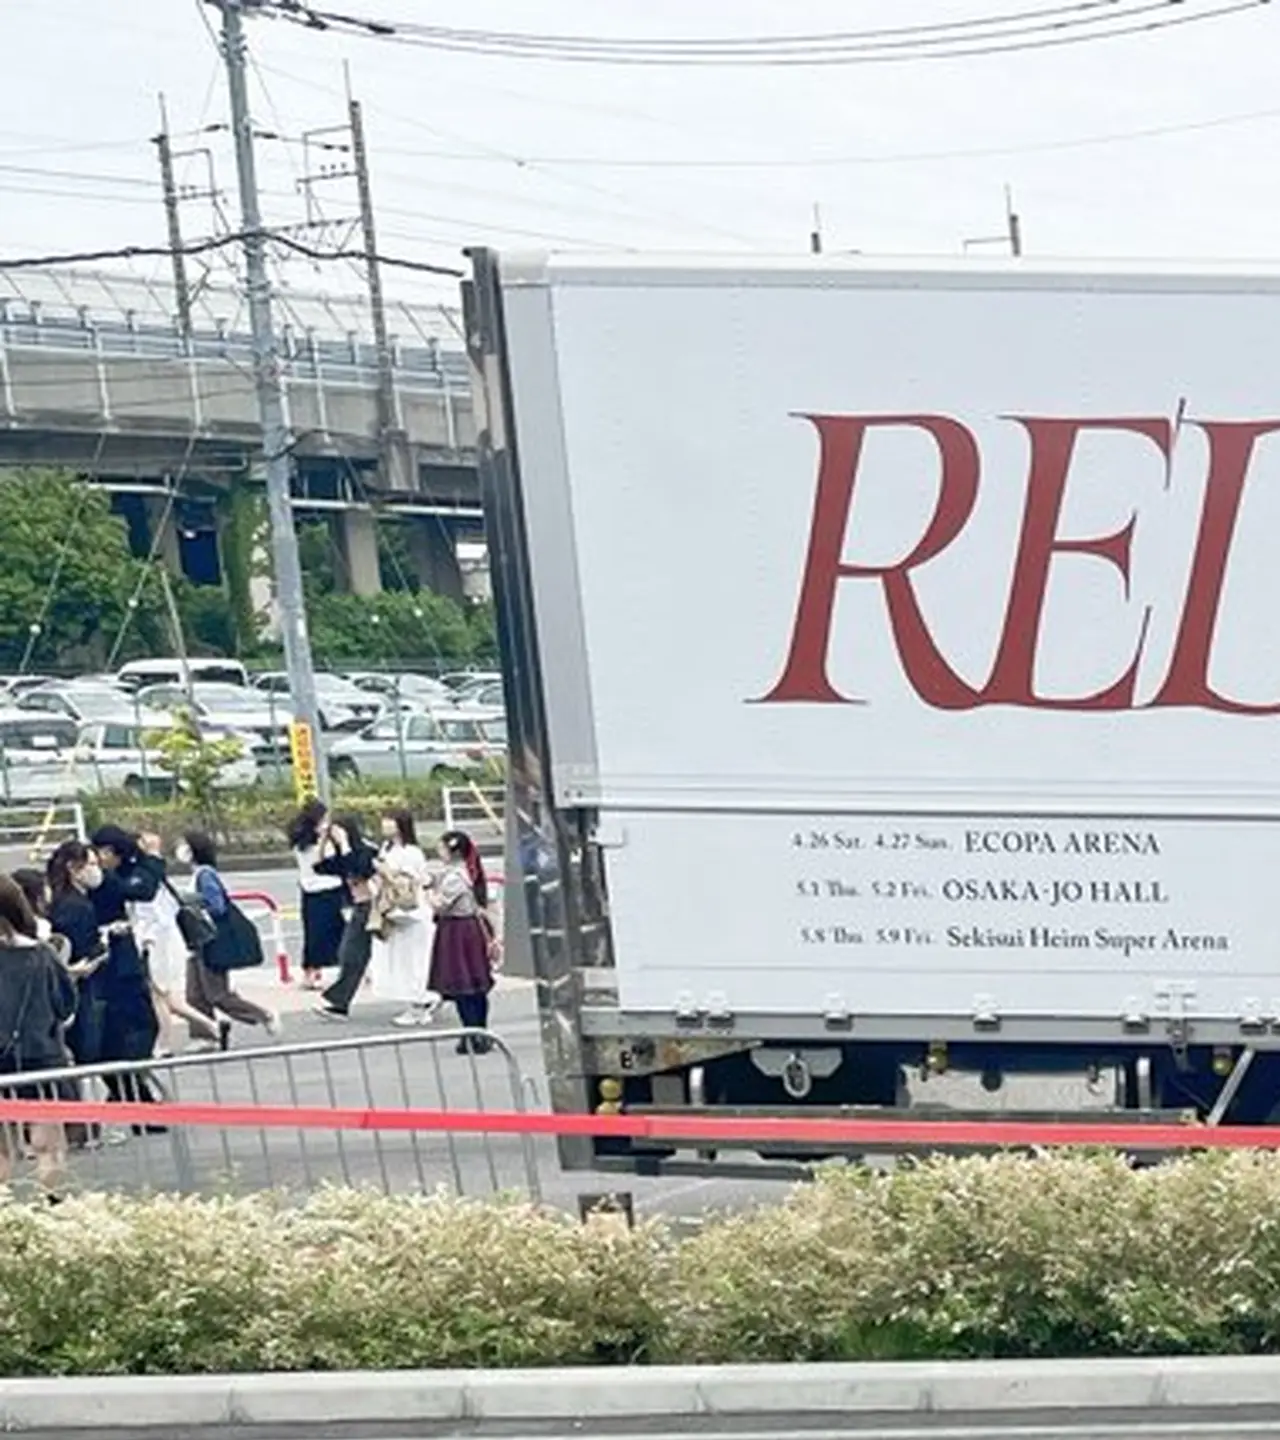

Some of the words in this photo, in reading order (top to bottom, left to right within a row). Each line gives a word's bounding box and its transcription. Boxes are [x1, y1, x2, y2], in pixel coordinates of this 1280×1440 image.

[792, 831, 830, 849] 4.26
[874, 832, 911, 850] 4.27
[965, 830, 1057, 854] ECOPA
[1063, 831, 1161, 855] ARENA
[796, 880, 820, 898] 5.1
[871, 880, 897, 898] 5.2
[942, 878, 1084, 907] OSAKA-JO
[1089, 880, 1170, 904] HALL
[875, 927, 901, 945] 5.9
[946, 925, 1025, 949] Sekisui
[1030, 926, 1091, 949] Heim
[1094, 926, 1157, 958] Super
[1161, 927, 1230, 951] Arena
